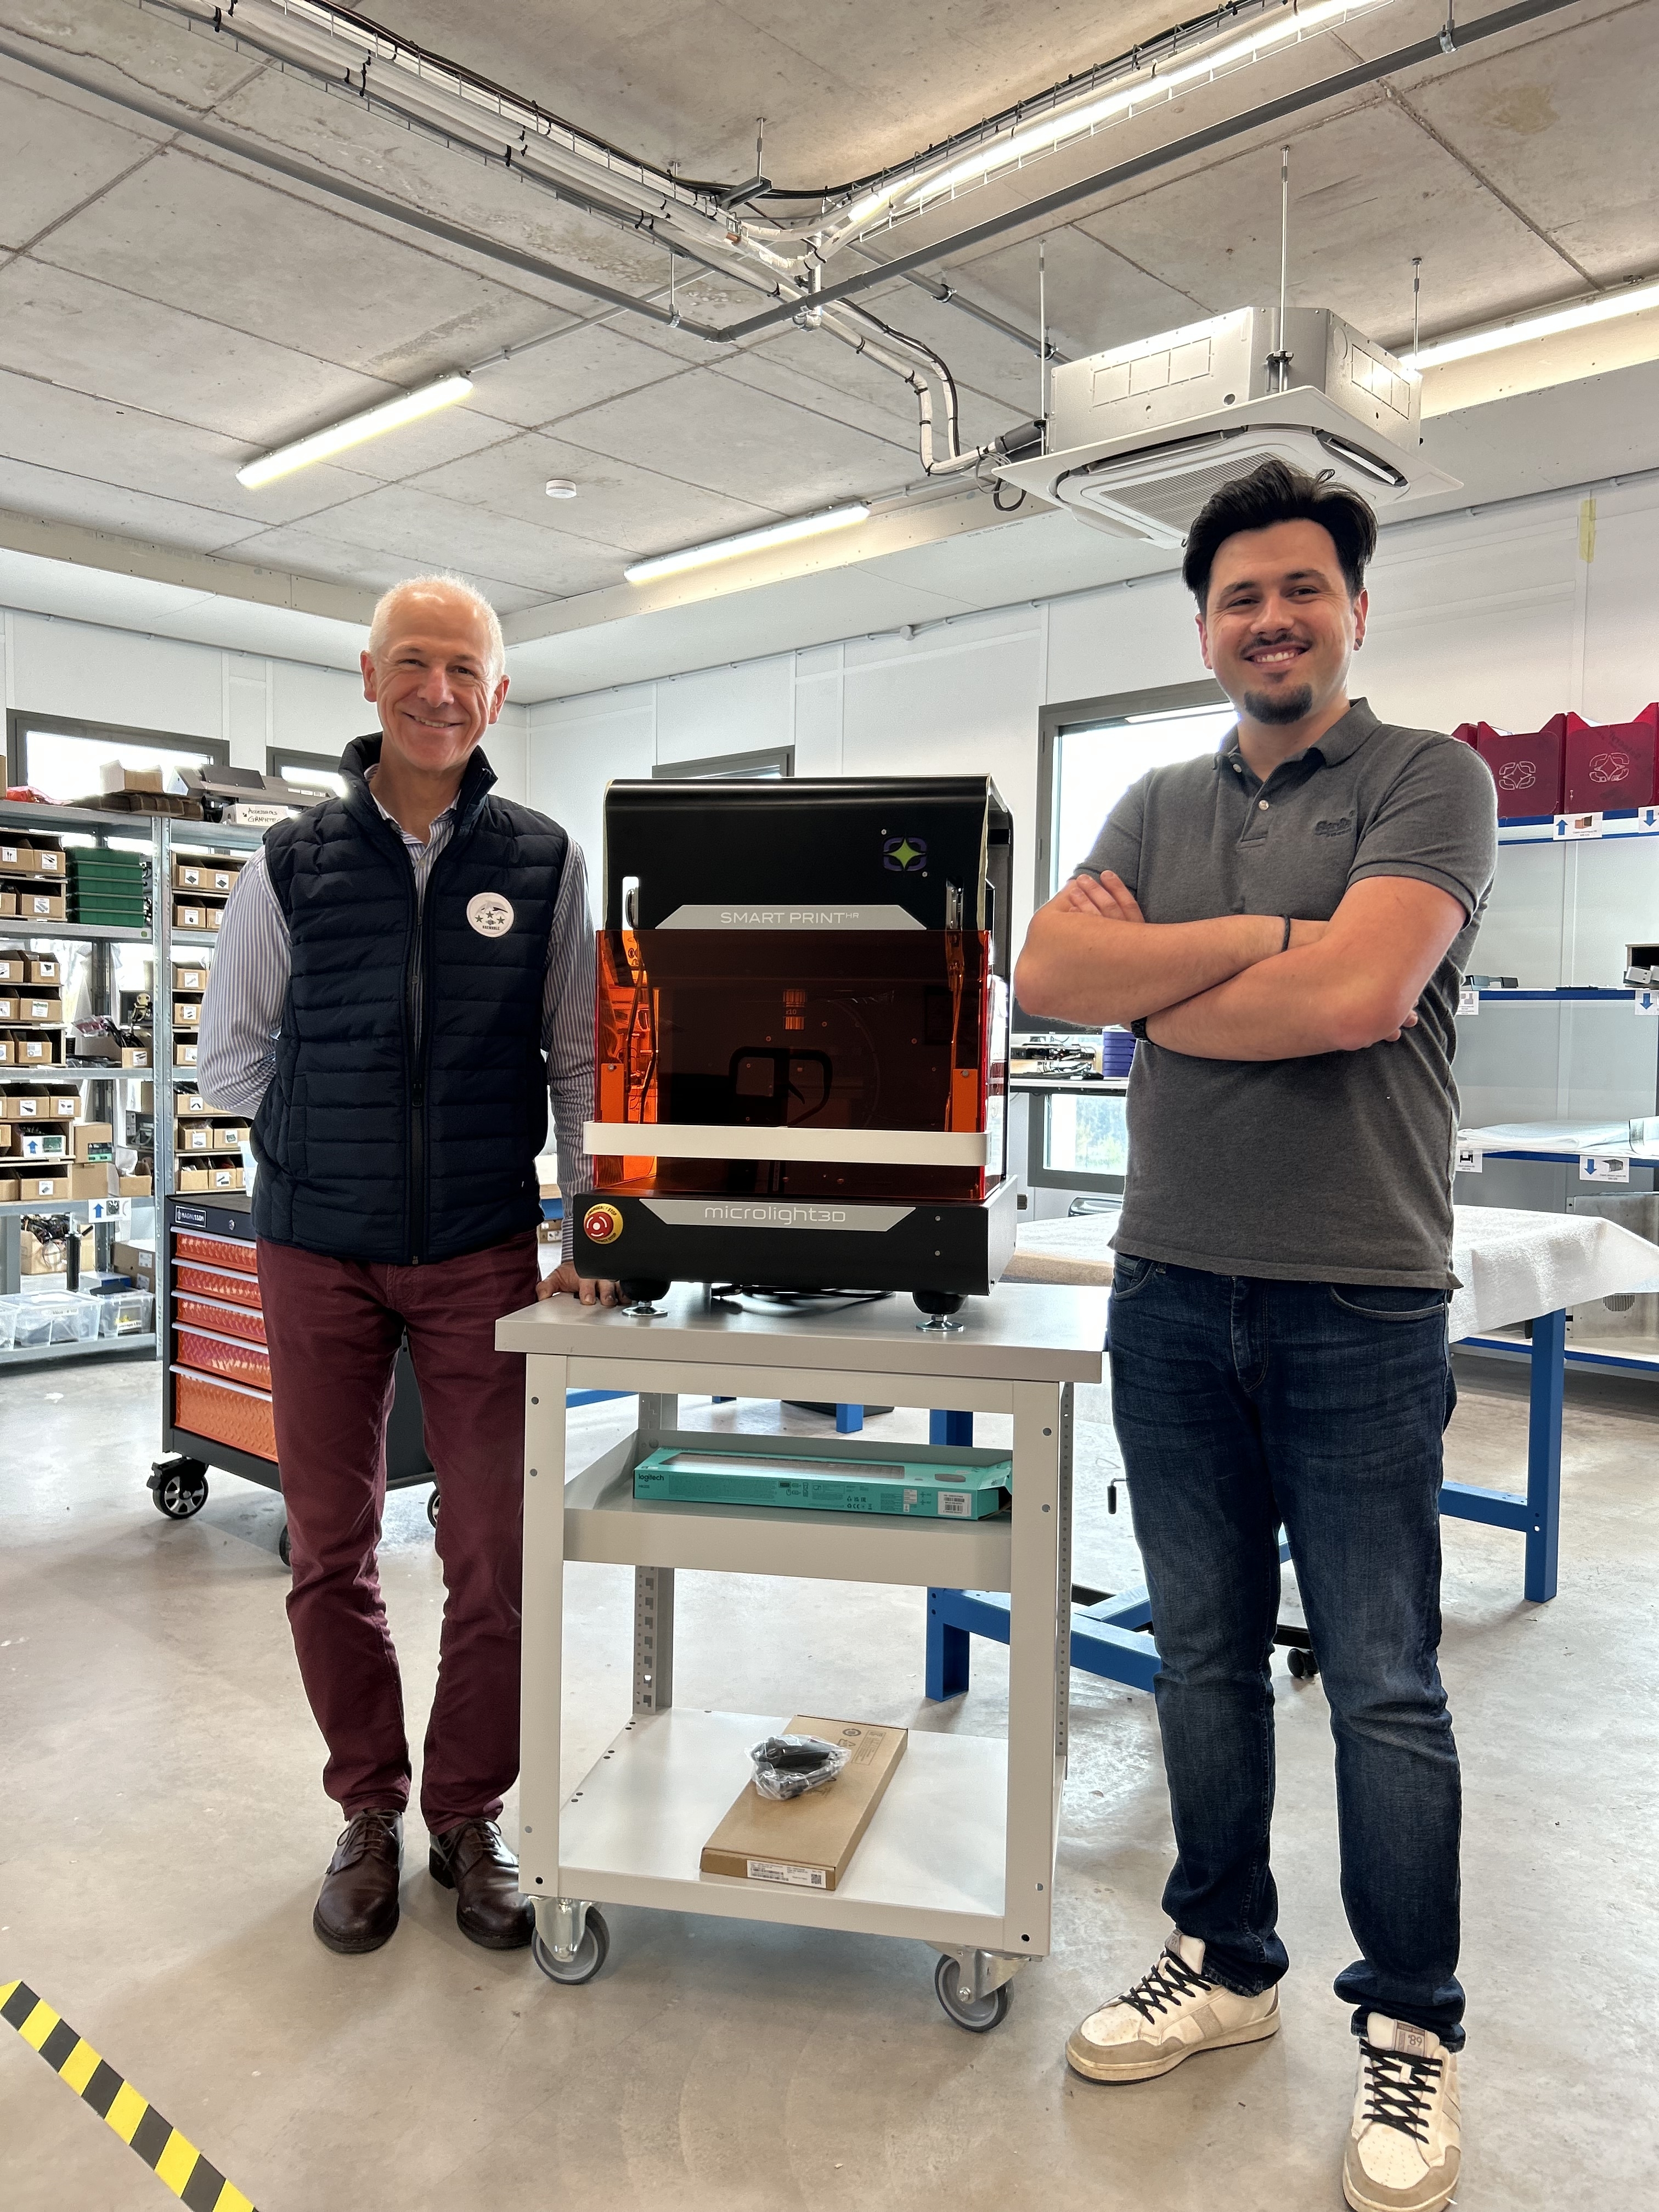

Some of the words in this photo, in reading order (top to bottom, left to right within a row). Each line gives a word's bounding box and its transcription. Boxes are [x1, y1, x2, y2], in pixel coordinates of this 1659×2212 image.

[720, 912, 785, 923] SMART
[704, 1206, 846, 1225] microlight3D
[638, 1473, 664, 1482] logitech
